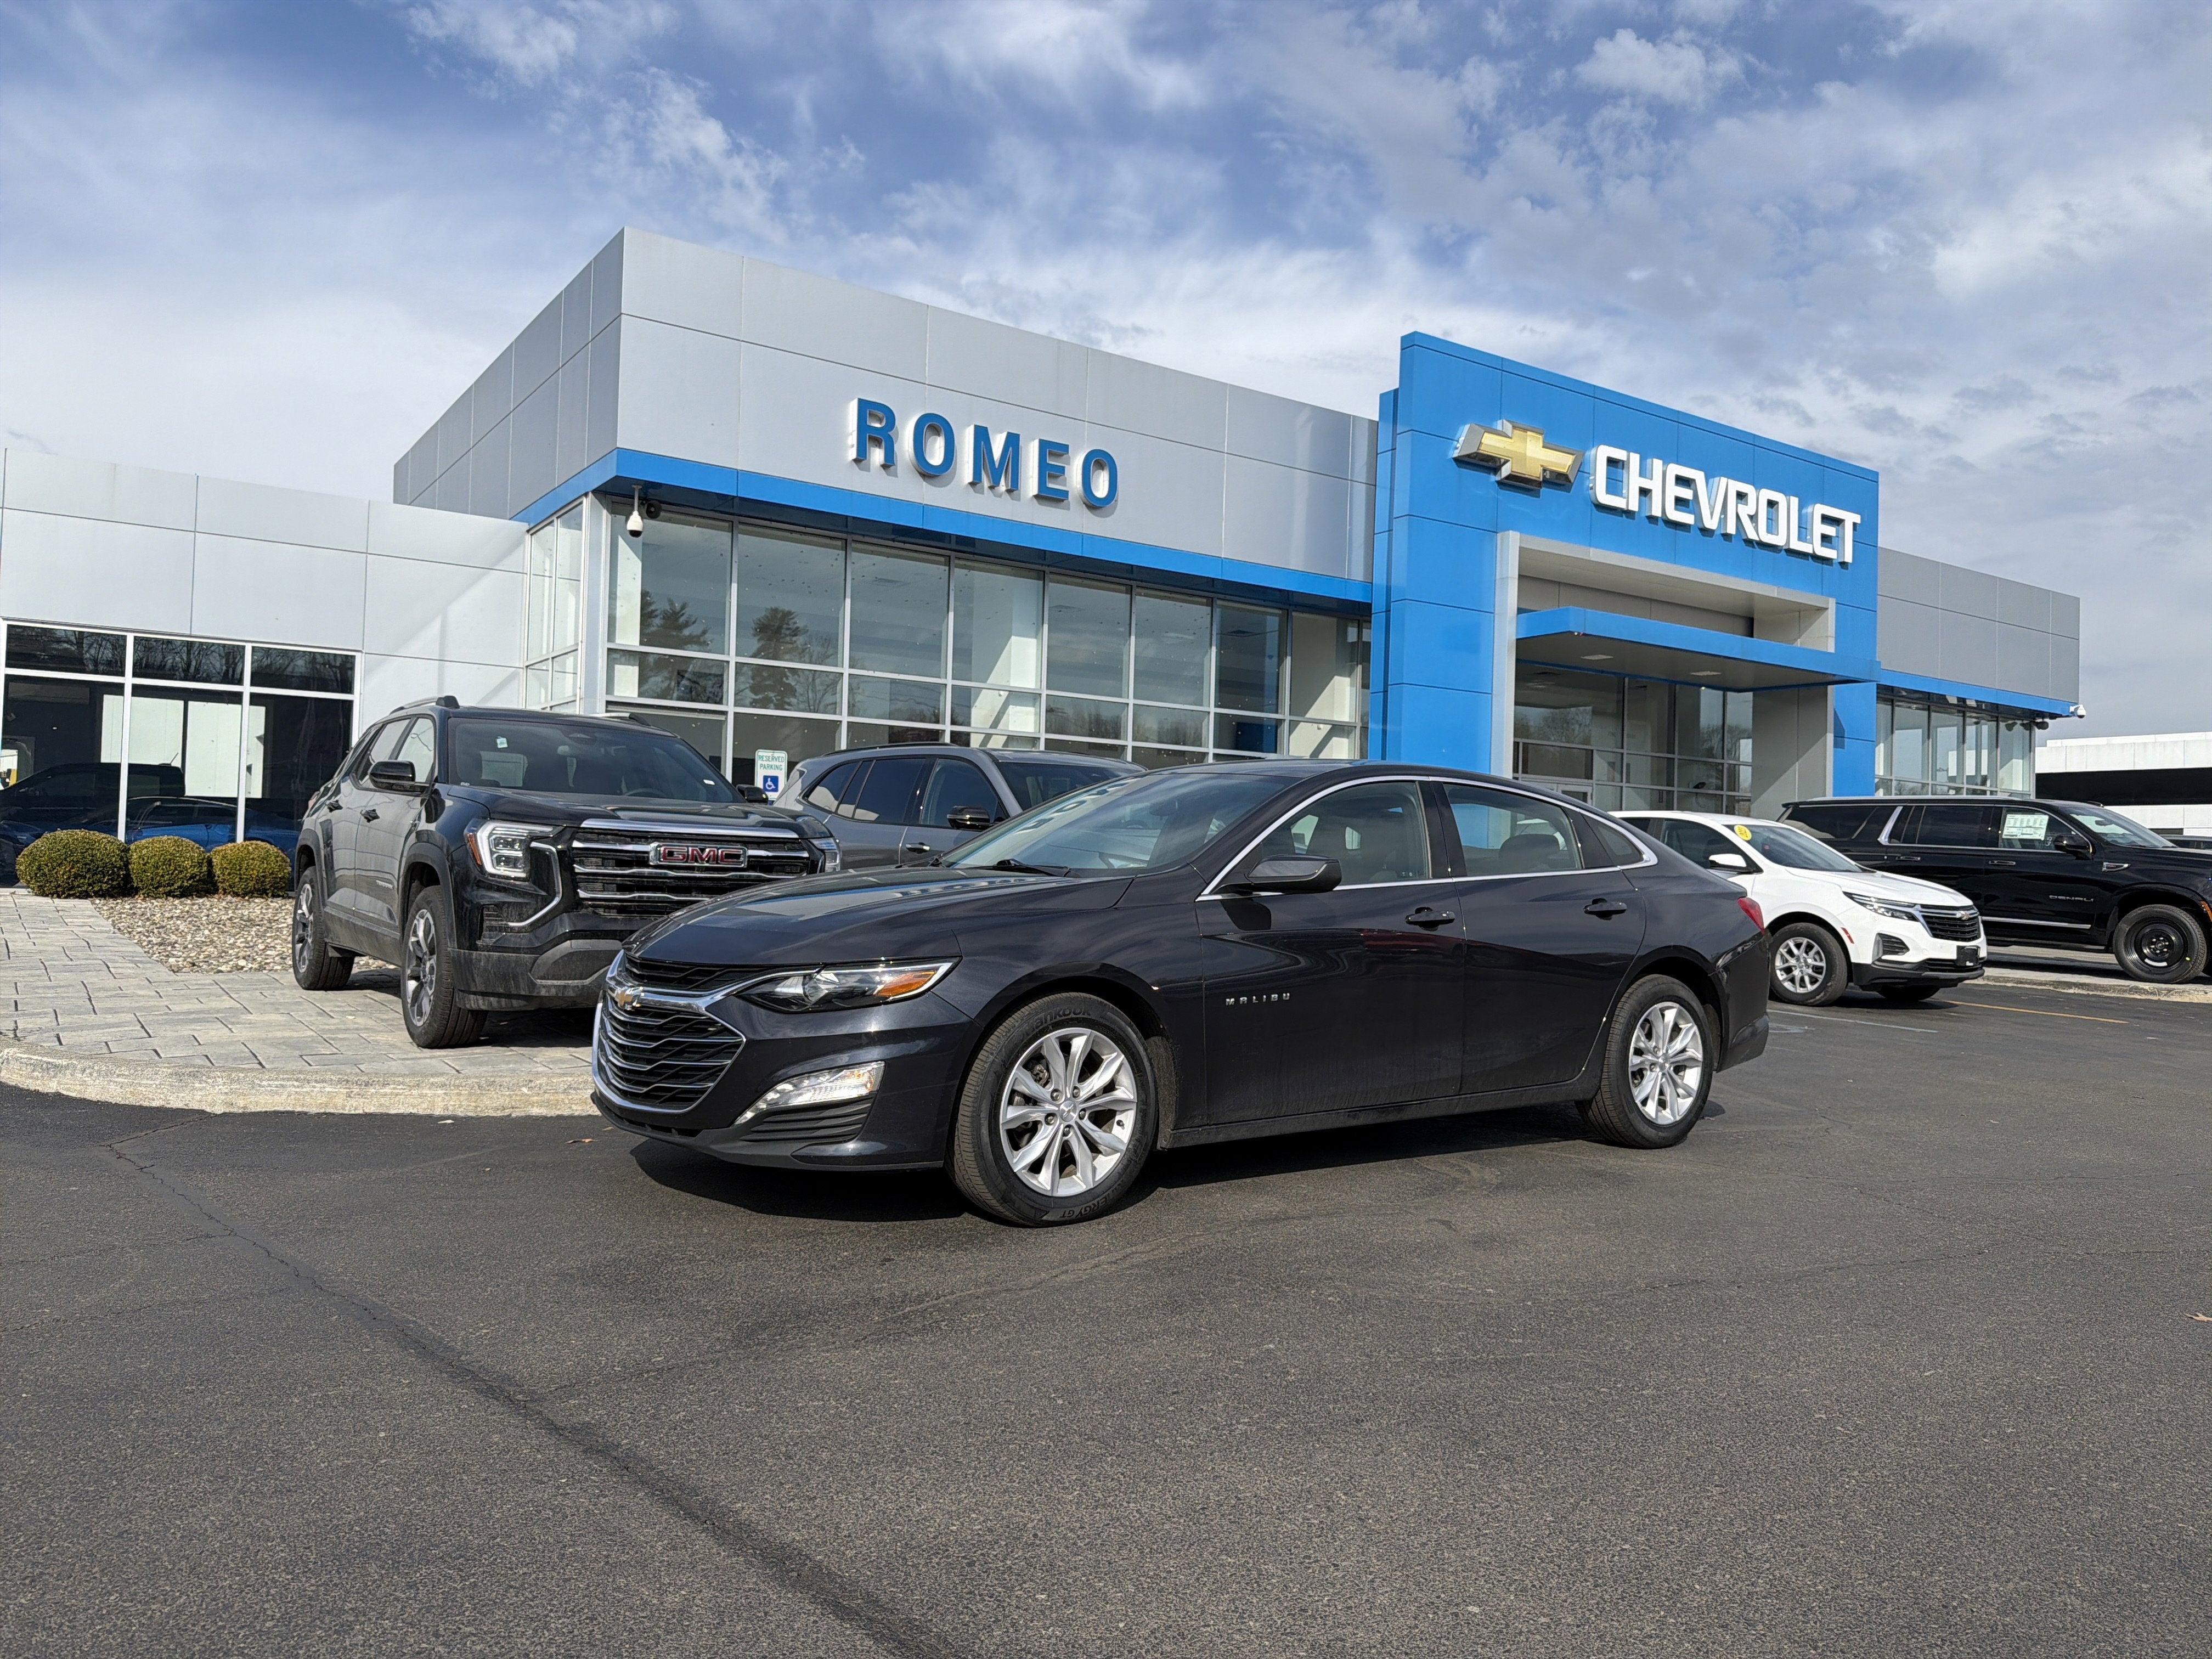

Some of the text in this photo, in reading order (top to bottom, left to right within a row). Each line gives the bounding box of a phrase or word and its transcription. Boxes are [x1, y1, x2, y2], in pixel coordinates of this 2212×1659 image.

[854, 397, 1119, 508] ROMEO
[1594, 444, 1861, 564] CHEVROLET
[661, 846, 743, 865] GMC
[1226, 993, 1290, 1006] MALIBU
